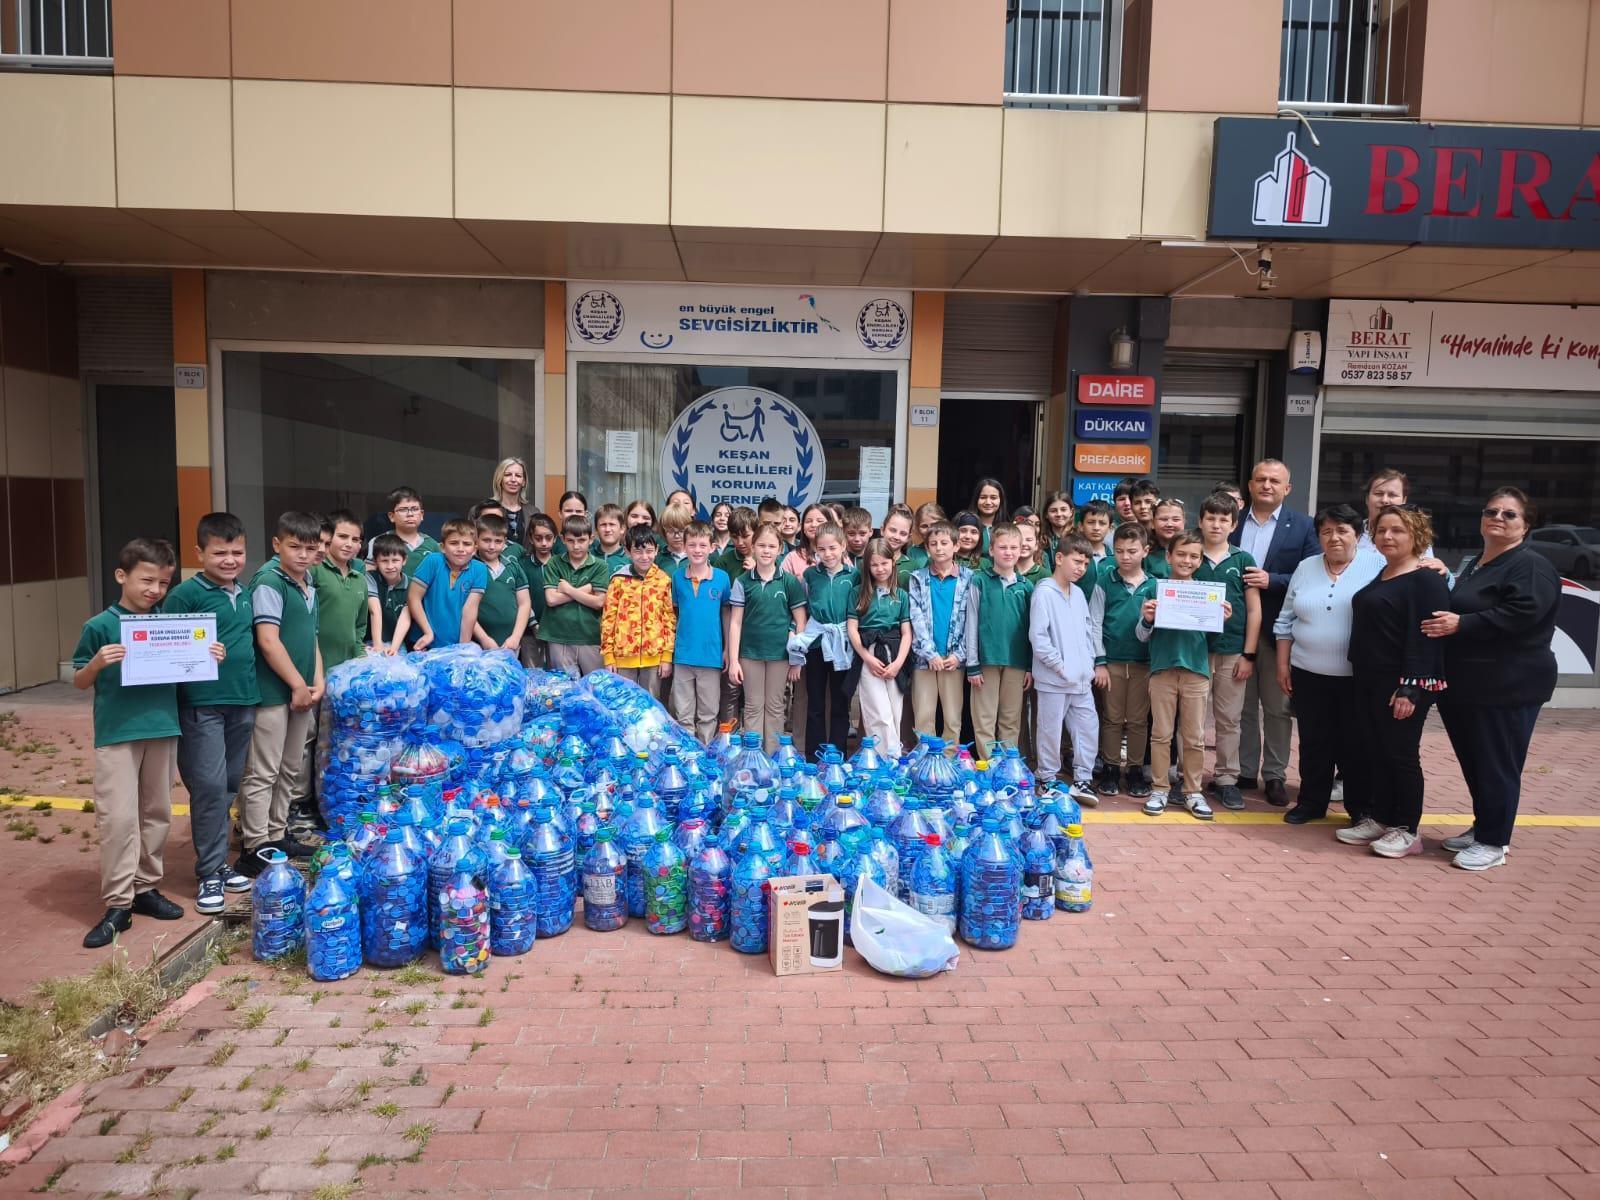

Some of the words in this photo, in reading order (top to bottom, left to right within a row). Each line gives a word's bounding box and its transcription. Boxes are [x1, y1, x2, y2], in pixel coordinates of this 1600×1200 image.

[699, 304, 736, 314] büyük
[740, 306, 774, 315] engel
[679, 317, 818, 333] SEVGİSİZLİKTİR
[1351, 331, 1411, 346] BERAT
[1348, 350, 1370, 358] YAPI
[1374, 349, 1410, 359] İNŞAAT
[1541, 334, 1564, 359] ki
[1567, 340, 1600, 369] Kon
[1341, 370, 1364, 380] 0537
[1367, 371, 1385, 380] 823
[1387, 371, 1398, 380] 58
[1401, 371, 1413, 380] 57
[1089, 379, 1144, 398] DAİRE
[1084, 417, 1145, 432] DÜKKAN
[719, 450, 770, 461] KEŞAN
[1079, 453, 1145, 466] PREFABRİK
[695, 464, 793, 475] ENGELLİLERİ
[712, 480, 777, 490] KORUMA
[1078, 482, 1097, 490] KAT
[711, 494, 777, 505] DERNE
